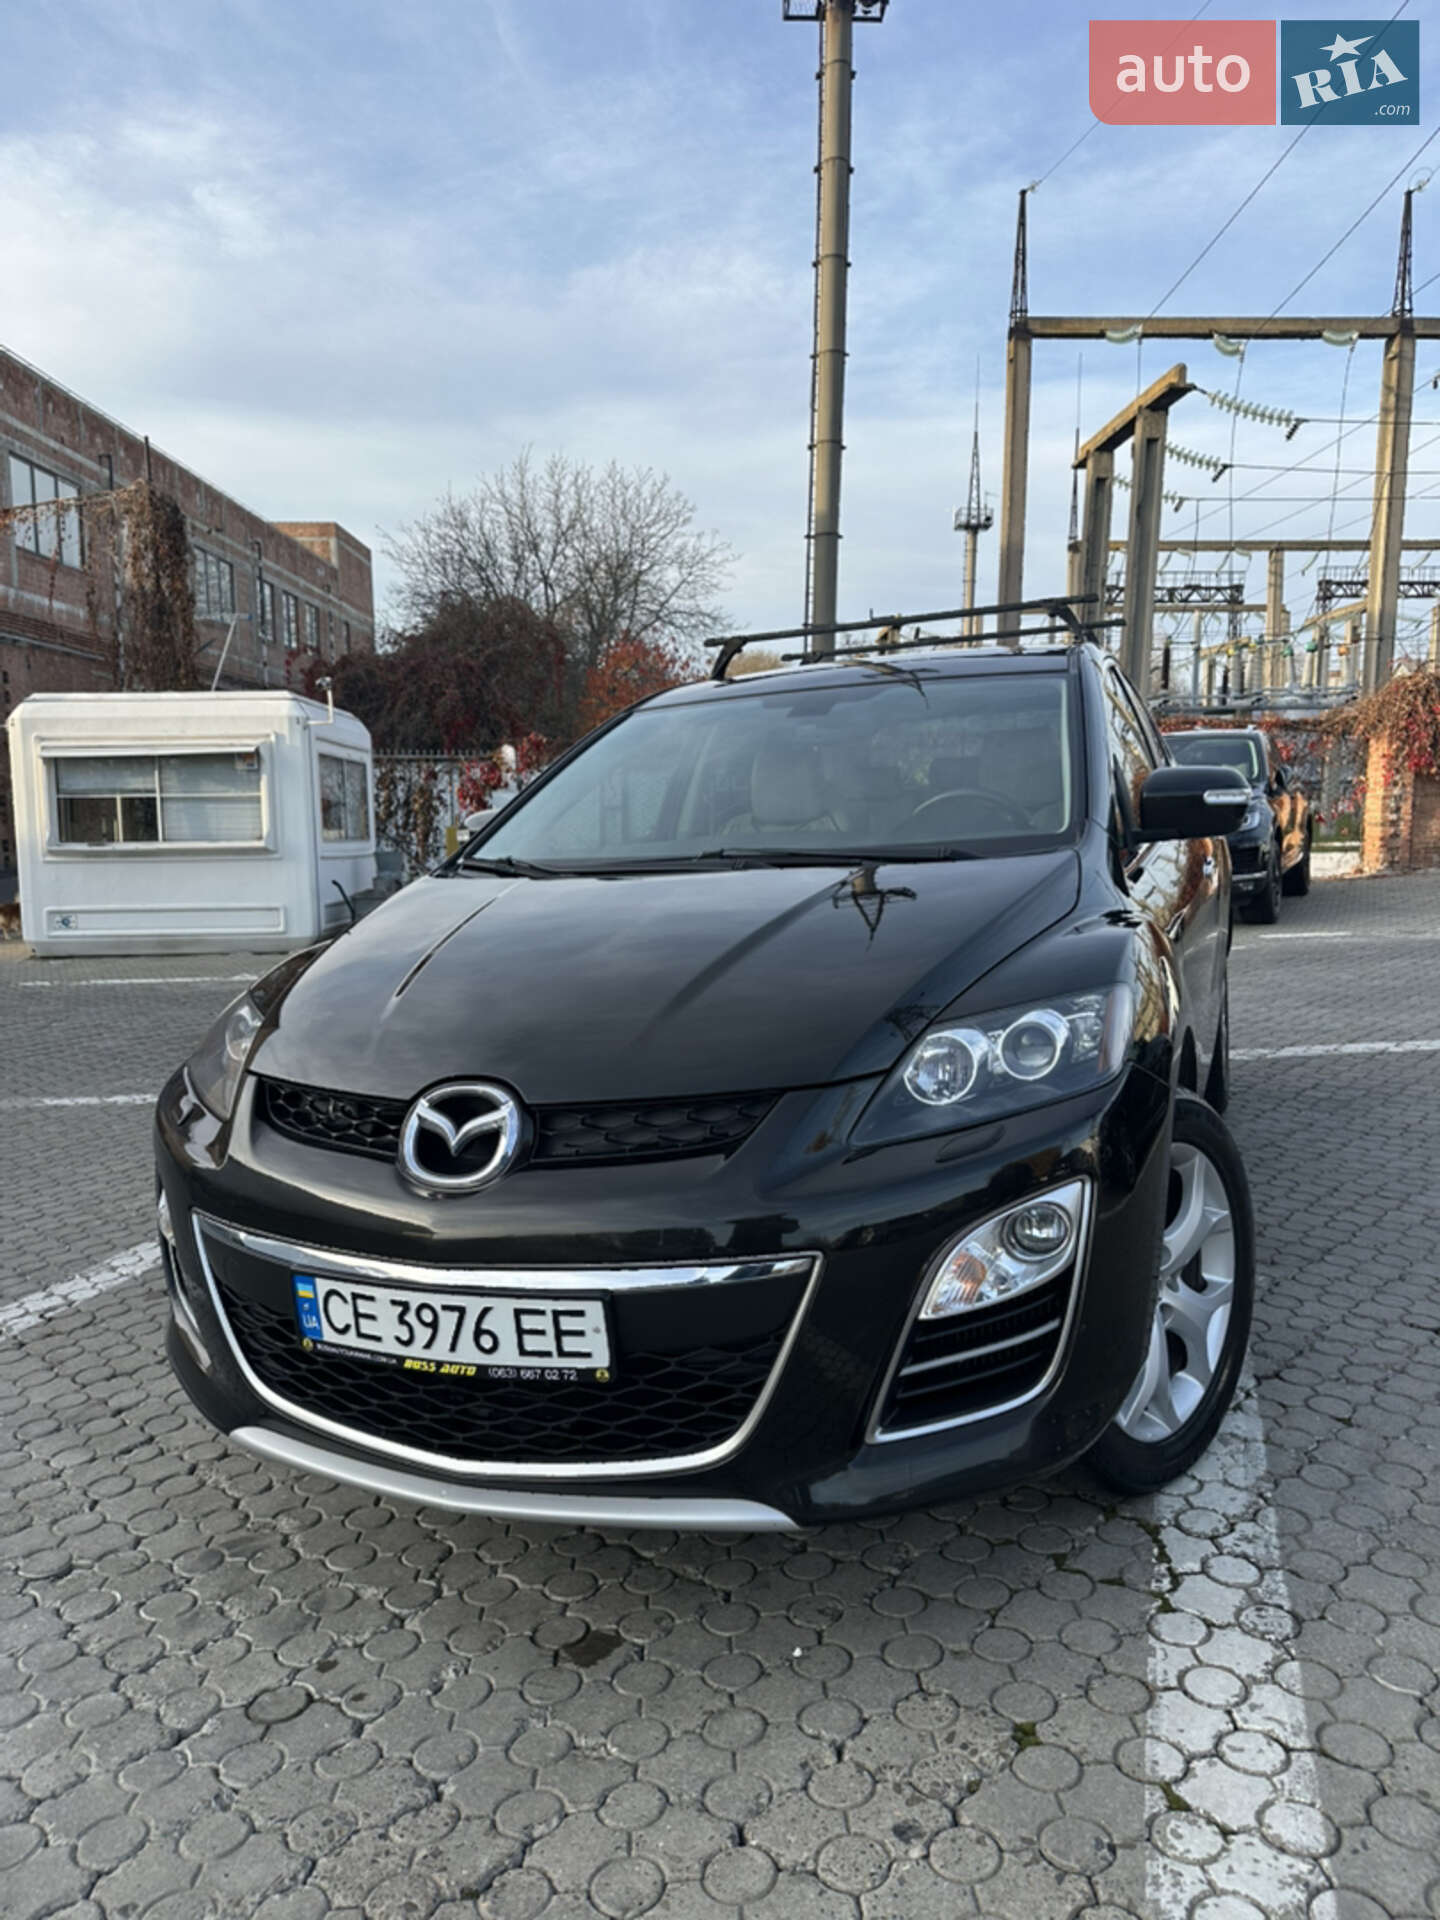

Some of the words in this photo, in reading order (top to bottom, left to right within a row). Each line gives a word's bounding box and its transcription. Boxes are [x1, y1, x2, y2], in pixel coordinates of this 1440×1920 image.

[302, 1313, 320, 1330] UA
[322, 1288, 382, 1343] CE
[389, 1298, 499, 1355] 3976
[513, 1307, 593, 1358] EE
[440, 1363, 477, 1376] AUTO
[544, 1369, 560, 1380] 02
[561, 1369, 578, 1381] 72
